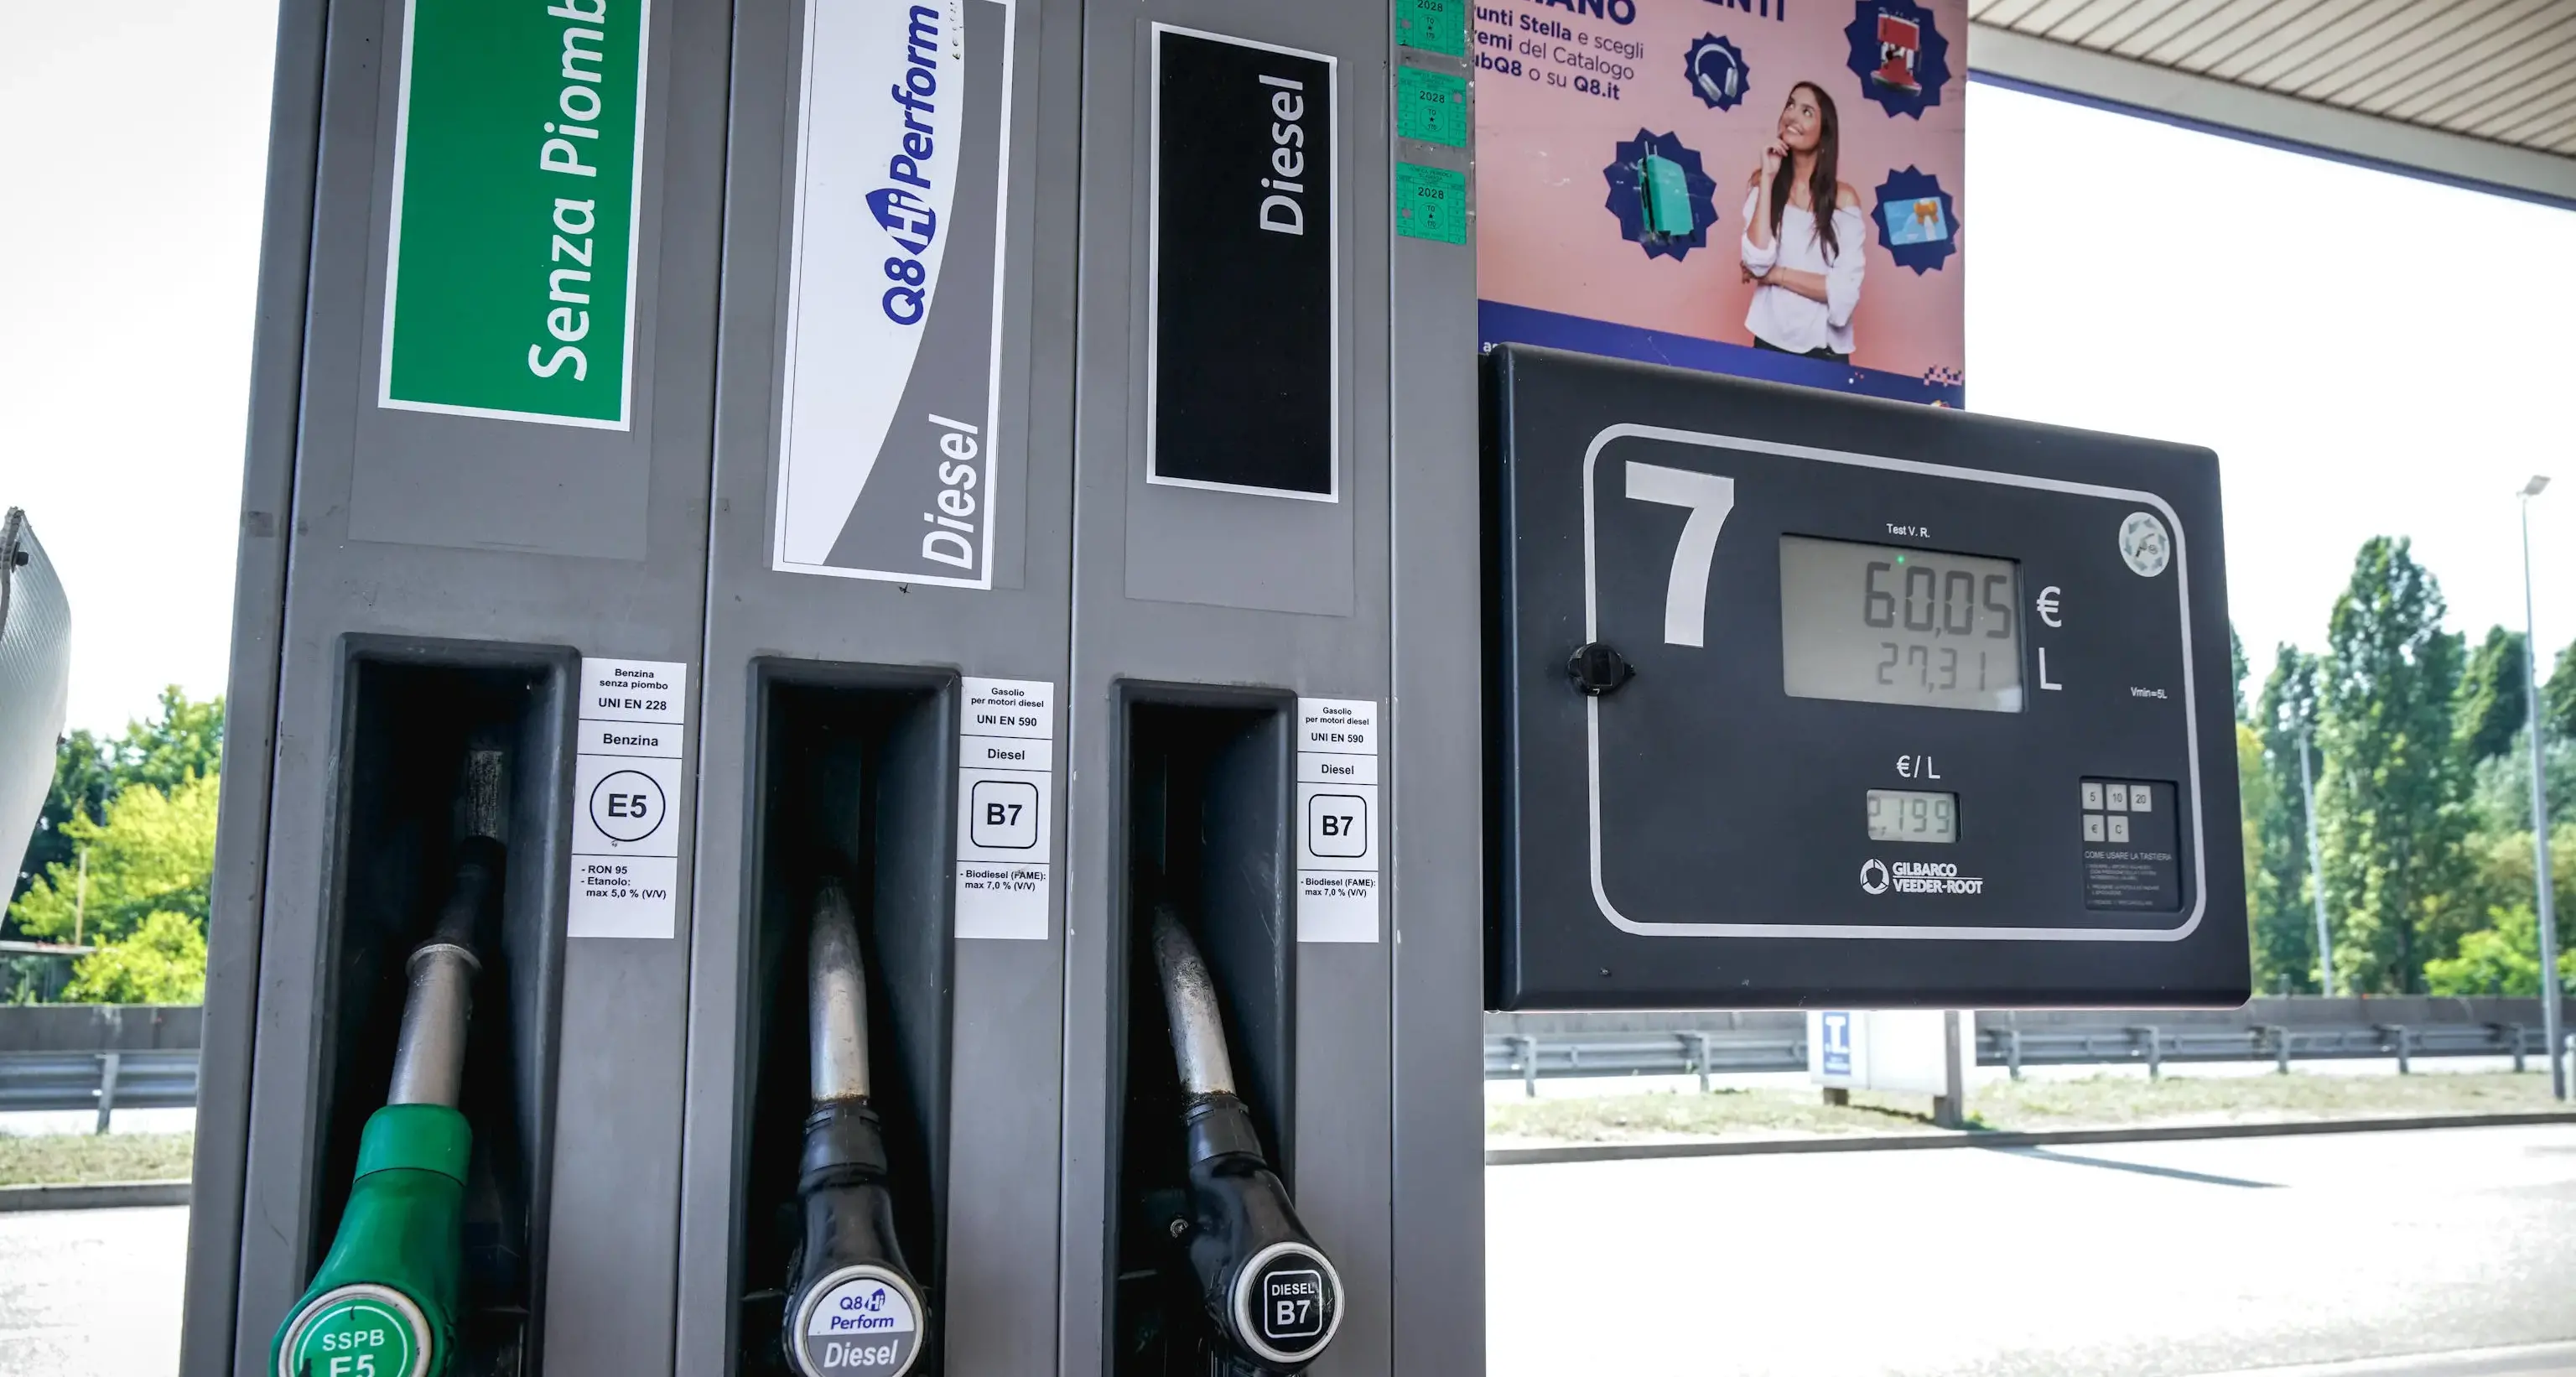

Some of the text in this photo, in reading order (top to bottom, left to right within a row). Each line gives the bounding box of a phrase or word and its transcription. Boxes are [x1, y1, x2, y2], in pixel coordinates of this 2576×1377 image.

[1417, 0, 1443, 12] 2028
[1474, 5, 1513, 27] unti
[1519, 14, 1571, 41] Stella
[1578, 32, 1588, 45] e
[1595, 35, 1644, 60] scegli
[1474, 30, 1634, 81] emi del Catalogo
[1529, 68, 1540, 81] o
[1547, 72, 1566, 87] su
[1574, 75, 1620, 100] Q8.it
[890, 4, 939, 190] Perform
[1419, 91, 1445, 103] 2028
[1259, 74, 1304, 236] Diesel
[527, 0, 606, 382] Senza Piomb
[1418, 187, 1444, 200] 2028
[882, 257, 926, 325] Q8
[922, 414, 979, 570] Diesel
[1887, 523, 1907, 536] Test
[1626, 460, 1734, 647] 7
[1864, 561, 2012, 639] 60,05
[2036, 585, 2062, 627] €
[615, 668, 654, 678] Benzina
[1878, 642, 1986, 693] 27,31
[2038, 647, 2062, 691] L
[599, 679, 668, 691] senza piombo
[991, 688, 1025, 697] Gasolio
[598, 698, 667, 711] UNI EN 228
[971, 698, 1044, 708] per motori diesel
[1322, 707, 1353, 715] Gasolio
[977, 714, 1037, 728] UNI EN 590
[1320, 716, 1345, 725] motori
[603, 733, 659, 747] Benzina
[1311, 732, 1364, 744] UNI EN 590
[988, 748, 1025, 761] Diesel
[1322, 764, 1354, 775] Diesel
[2090, 792, 2096, 802] 5
[2112, 792, 2123, 803] 10
[2136, 793, 2147, 804] 20
[608, 793, 647, 818] E5
[987, 803, 1022, 826] B7
[1322, 814, 1353, 837] B7
[588, 865, 613, 875] RON
[615, 865, 628, 876] 95
[966, 870, 1009, 880] Biodiesel
[1010, 870, 1046, 881] (FAME):
[1892, 862, 1958, 876] GILBARCO
[587, 876, 631, 886] Etanolo:
[986, 881, 1000, 891] 7,0
[1002, 881, 1011, 891] %
[1014, 881, 1036, 892] (V/V)
[1306, 878, 1343, 886] Biodiesel
[1345, 878, 1376, 888] (FAME):
[1892, 878, 1984, 894] VEEDER-ROOT
[586, 888, 667, 901] max 5,0 % (V/V)
[1324, 888, 1337, 897] 7,0
[1337, 888, 1346, 896] %
[1348, 889, 1367, 898] (V/V)
[1271, 1282, 1316, 1296] DIESEL
[840, 1296, 863, 1310] Q8
[1277, 1300, 1311, 1326] B7
[830, 1314, 894, 1330] Perform
[322, 1328, 386, 1352] SSPB
[823, 1339, 899, 1369] Diesel
[330, 1354, 376, 1377] E5
